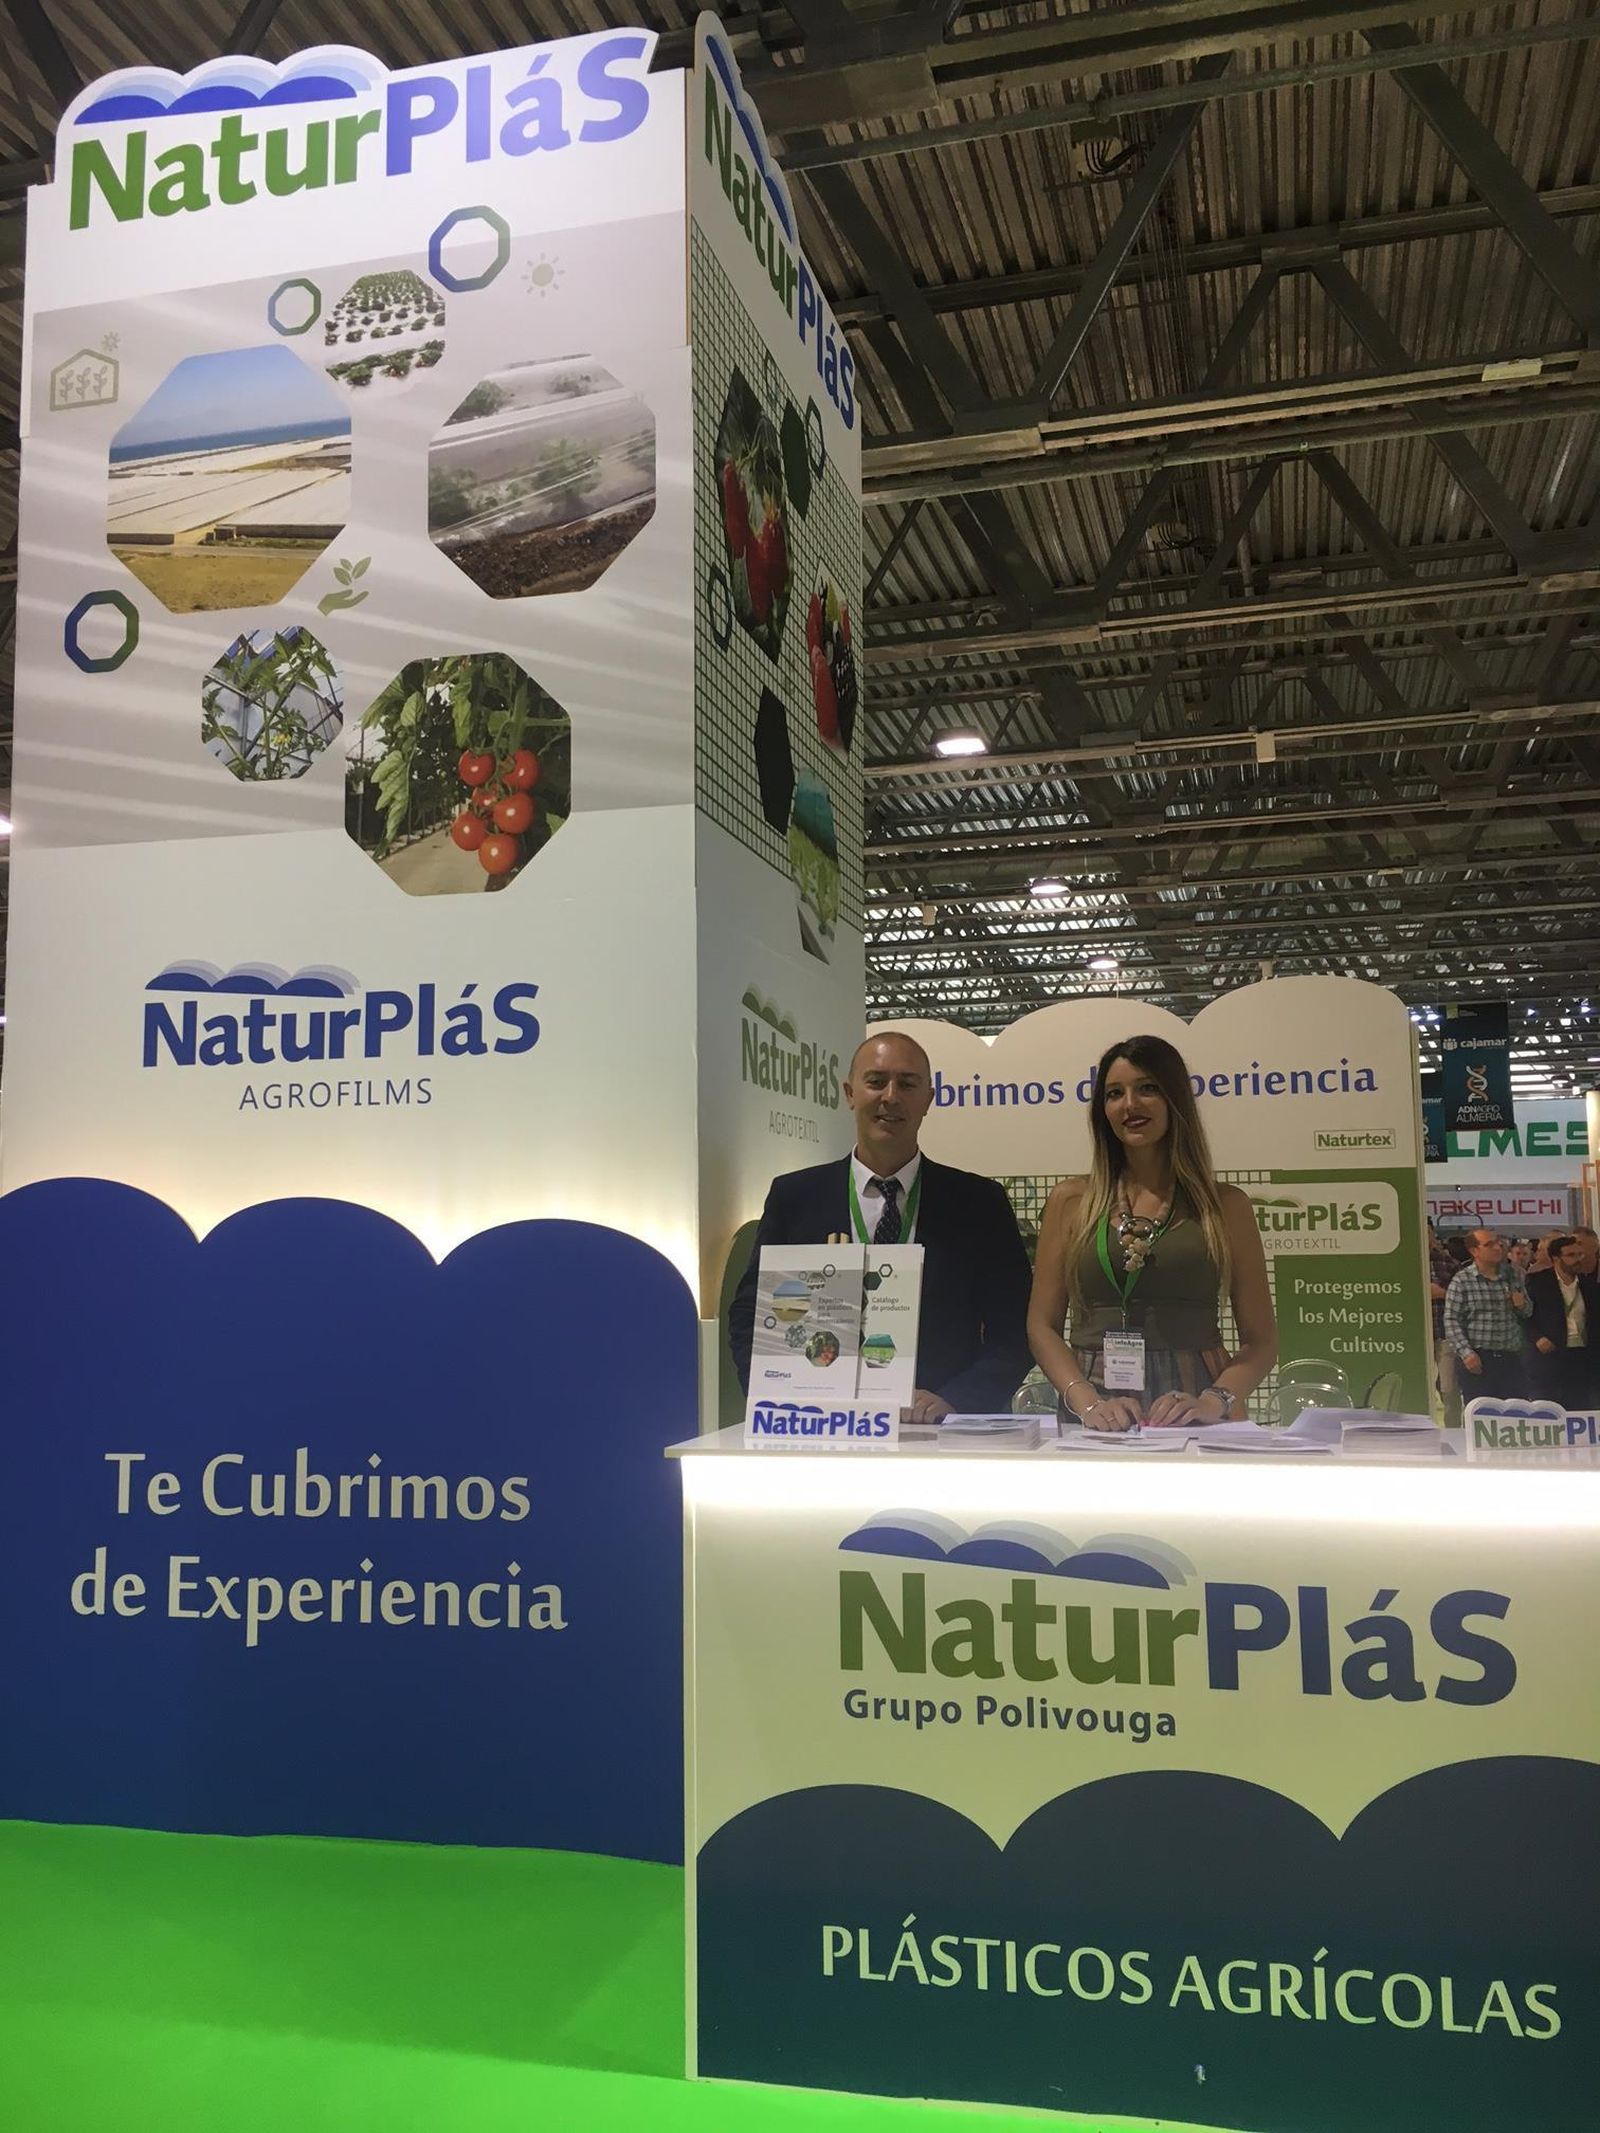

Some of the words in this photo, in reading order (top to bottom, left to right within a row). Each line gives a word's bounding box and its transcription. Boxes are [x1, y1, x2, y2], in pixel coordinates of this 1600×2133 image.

[69, 37, 649, 231] NaturPláS
[704, 64, 855, 431] NaturPláS
[143, 983, 540, 1067] NaturPláS
[1460, 1037, 1507, 1049] cajamar
[741, 1017, 840, 1110] NaturPláS
[239, 1078, 433, 1110] AGROFILMS
[769, 1110, 820, 1143] AGROTEXTIL
[1317, 1133, 1392, 1147] Naturtex
[1294, 1278, 1402, 1300] Protegemos
[1299, 1306, 1325, 1323] los
[1329, 1307, 1404, 1329] Mejores
[1330, 1335, 1405, 1353] Cultivos
[752, 1400, 890, 1437] NaturPláS
[1473, 1416, 1600, 1448] NaturPl
[105, 1453, 181, 1514] Te
[203, 1447, 531, 1522] Cubrimos
[71, 1546, 146, 1615] de
[168, 1555, 568, 1647] Experiencia
[838, 1570, 1518, 1706] NaturPláS
[844, 1689, 964, 1729] Grupo
[976, 1695, 1177, 1743] Polivouga
[822, 1914, 1154, 2005] PLÁSTICOS
[1169, 1948, 1562, 2040] AGRÍCOLAS
